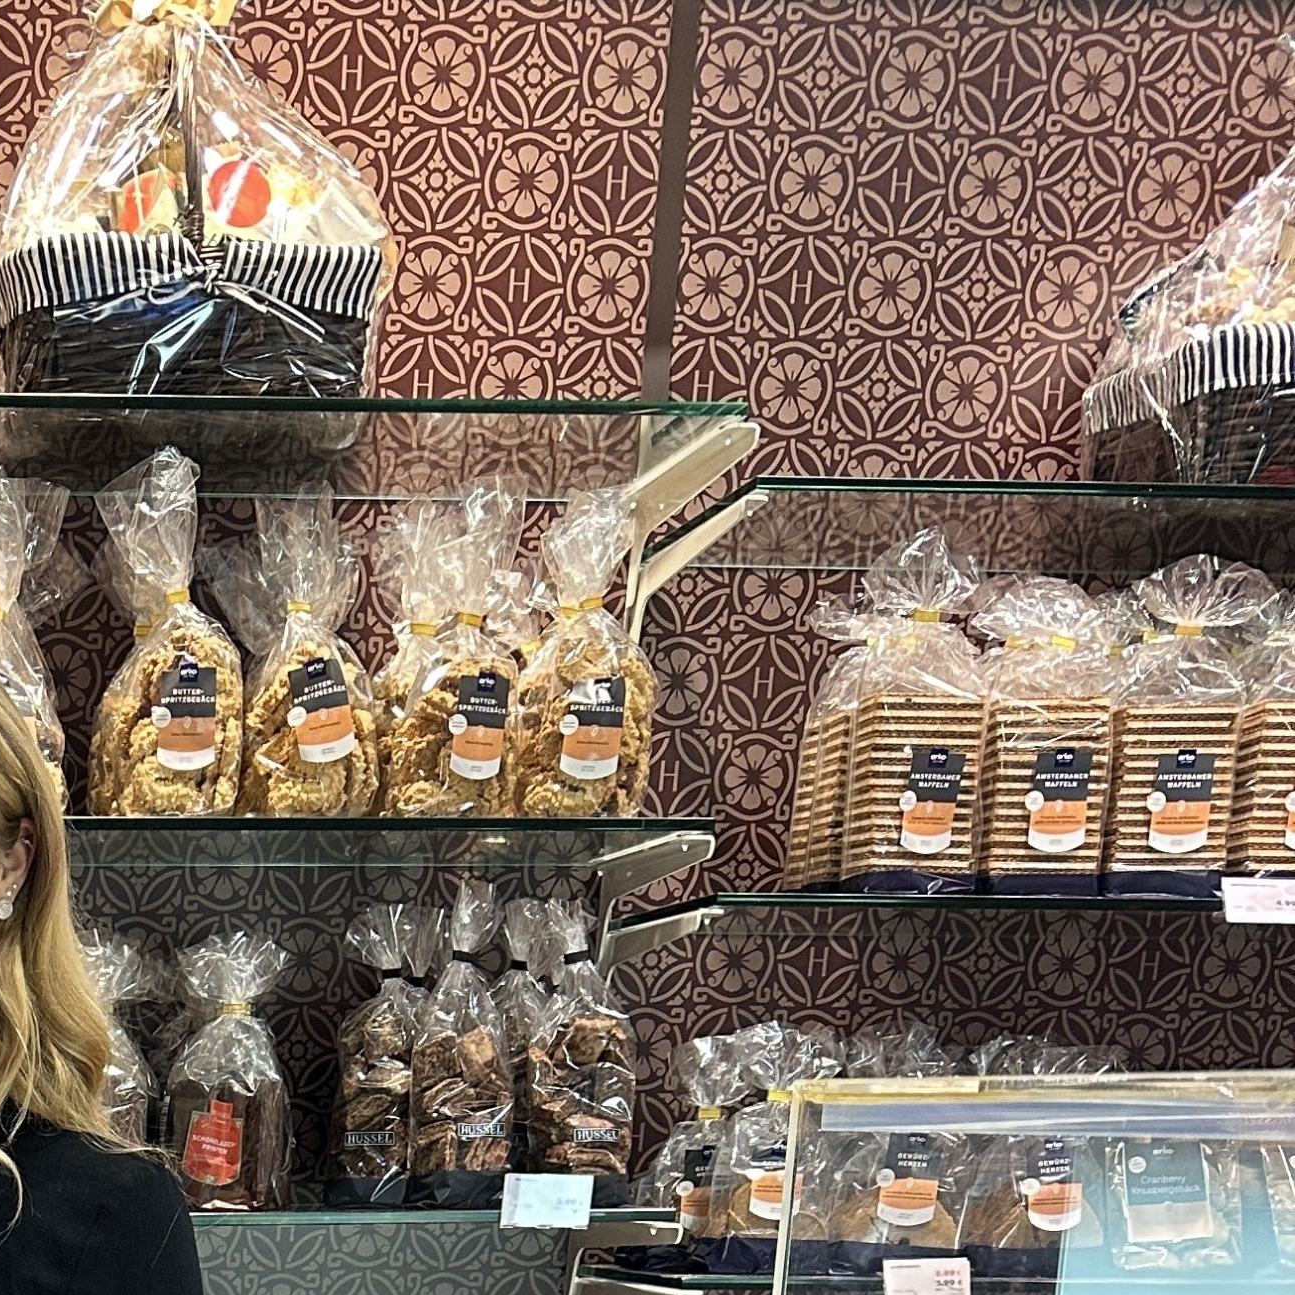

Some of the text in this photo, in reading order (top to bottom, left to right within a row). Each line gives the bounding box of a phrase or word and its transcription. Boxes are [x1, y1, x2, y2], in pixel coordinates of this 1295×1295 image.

[460, 1124, 504, 1136] HUSSEL
[577, 1129, 618, 1141] HUSSEL
[347, 1134, 393, 1145] HUSSEL
[1140, 1175, 1186, 1184] Cranberry
[1131, 1184, 1202, 1195] Knuspergebäck
